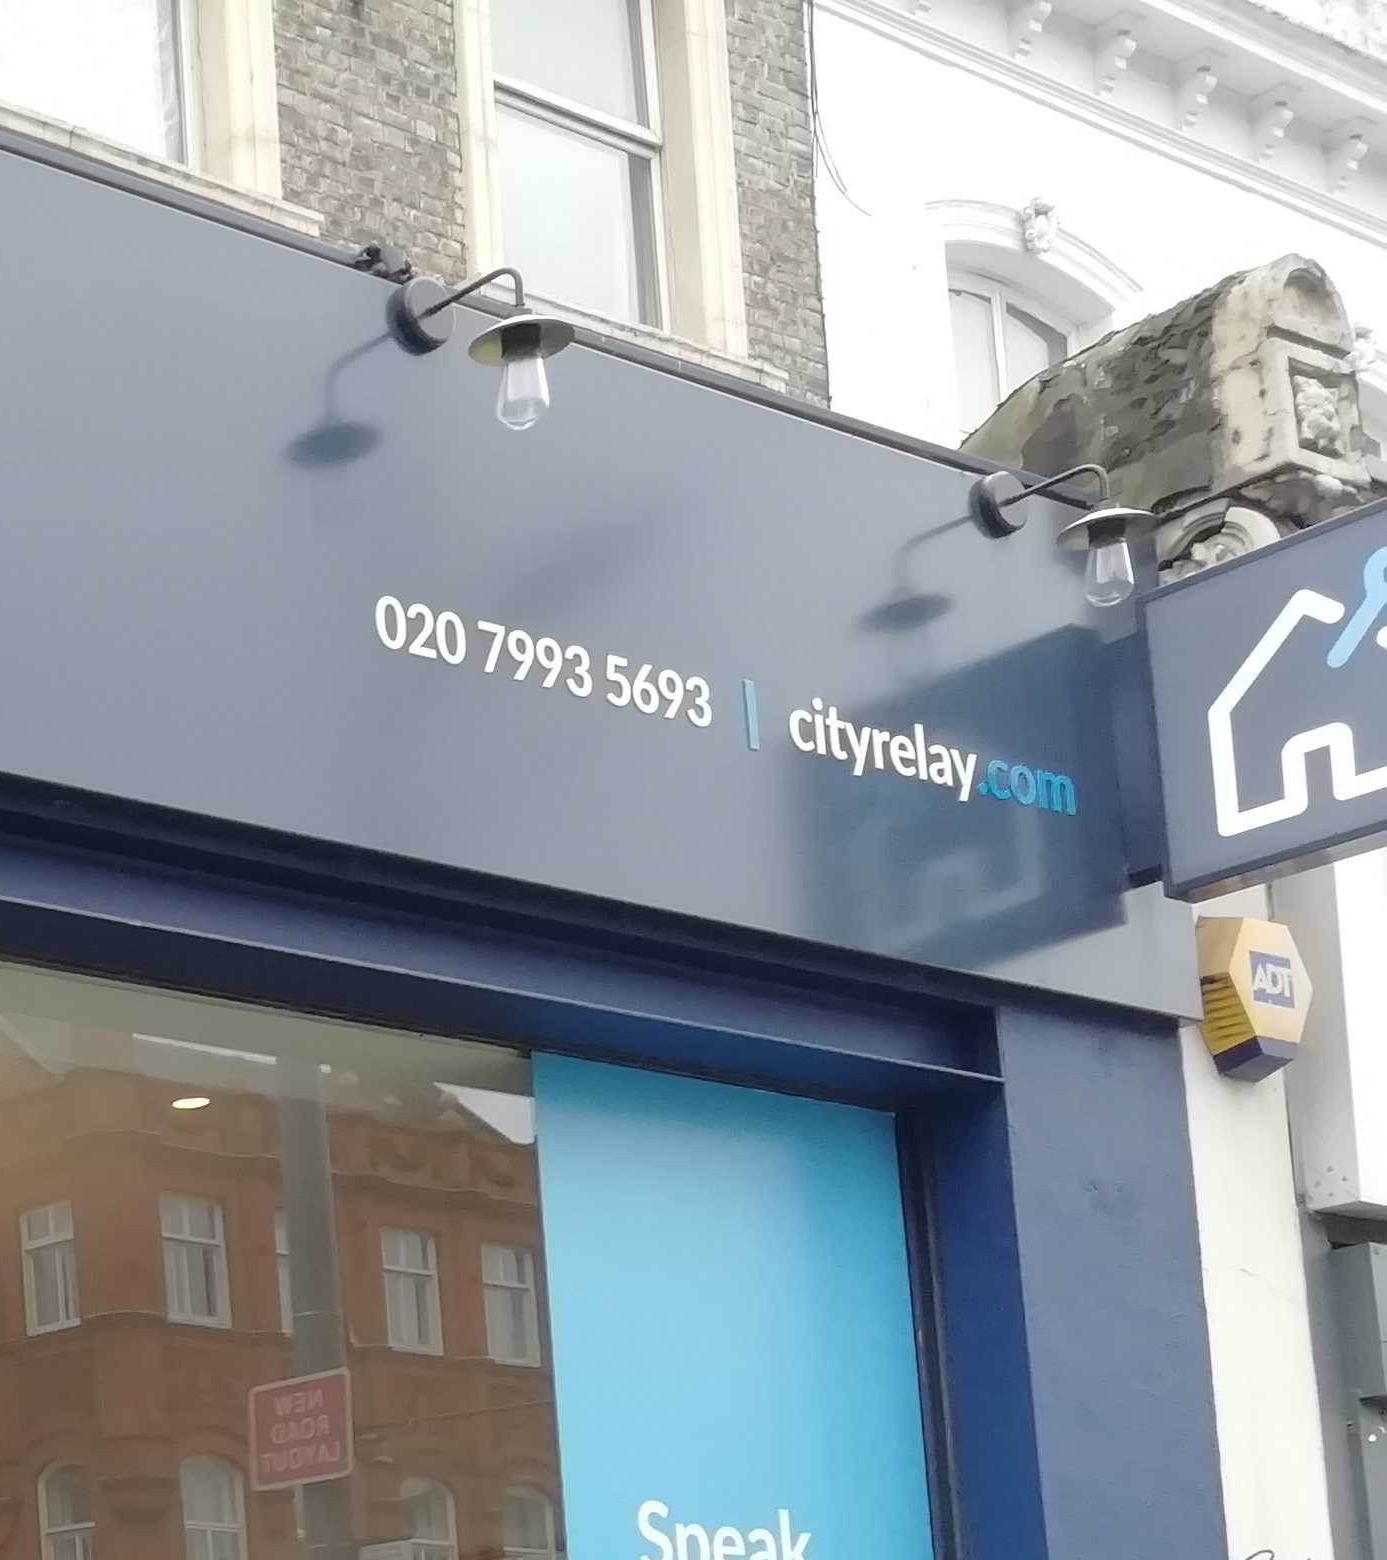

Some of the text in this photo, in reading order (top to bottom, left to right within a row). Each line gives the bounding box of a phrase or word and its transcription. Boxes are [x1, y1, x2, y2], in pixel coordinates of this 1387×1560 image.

[375, 595, 1076, 816] 020 7993 5693 cityrelay.com
[1252, 963, 1292, 998] ADT
